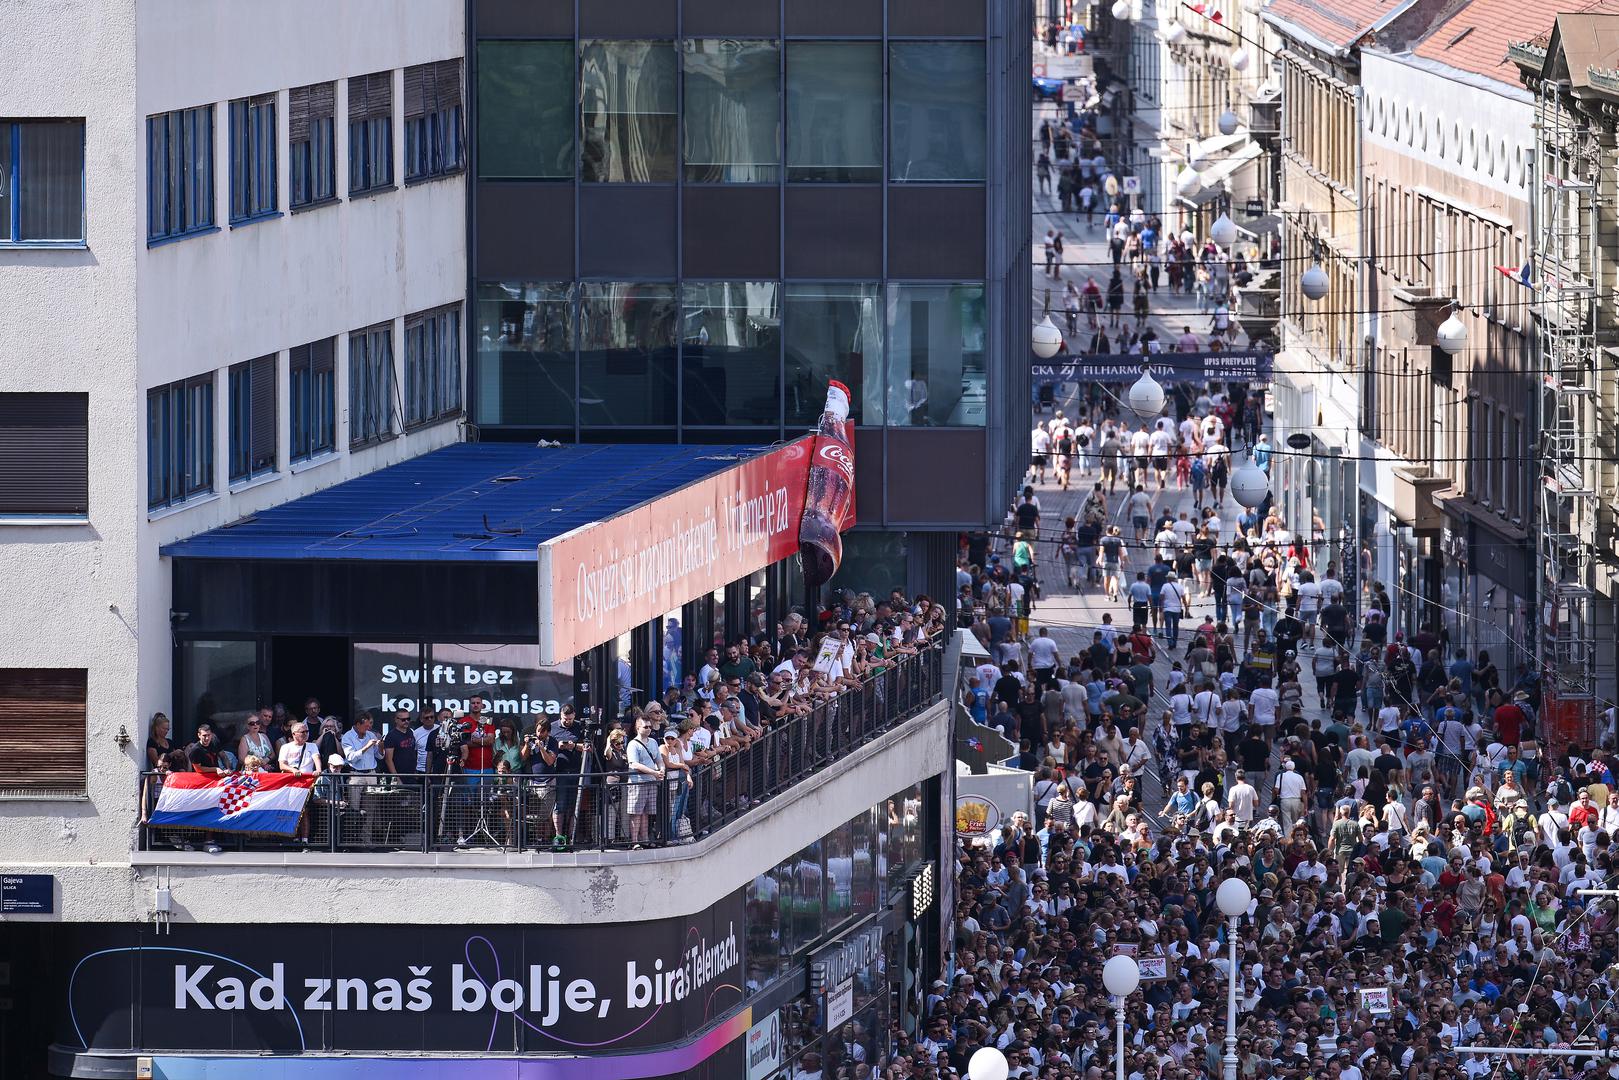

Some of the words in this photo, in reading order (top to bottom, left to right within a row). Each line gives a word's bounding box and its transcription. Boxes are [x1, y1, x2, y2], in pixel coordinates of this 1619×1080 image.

[1204, 357, 1219, 366] UPIS
[1220, 357, 1256, 366] PRETPLATE
[724, 490, 765, 563] Vrijeme
[764, 480, 775, 552] je
[776, 486, 789, 534] za
[577, 547, 619, 629] Osvježi
[621, 558, 634, 604] se
[640, 521, 677, 604] napuni
[464, 665, 513, 685] bez
[174, 962, 285, 1011] Kad
[304, 965, 433, 1012] znaš
[451, 963, 611, 1027] bolje,
[626, 955, 691, 1009] biraš
